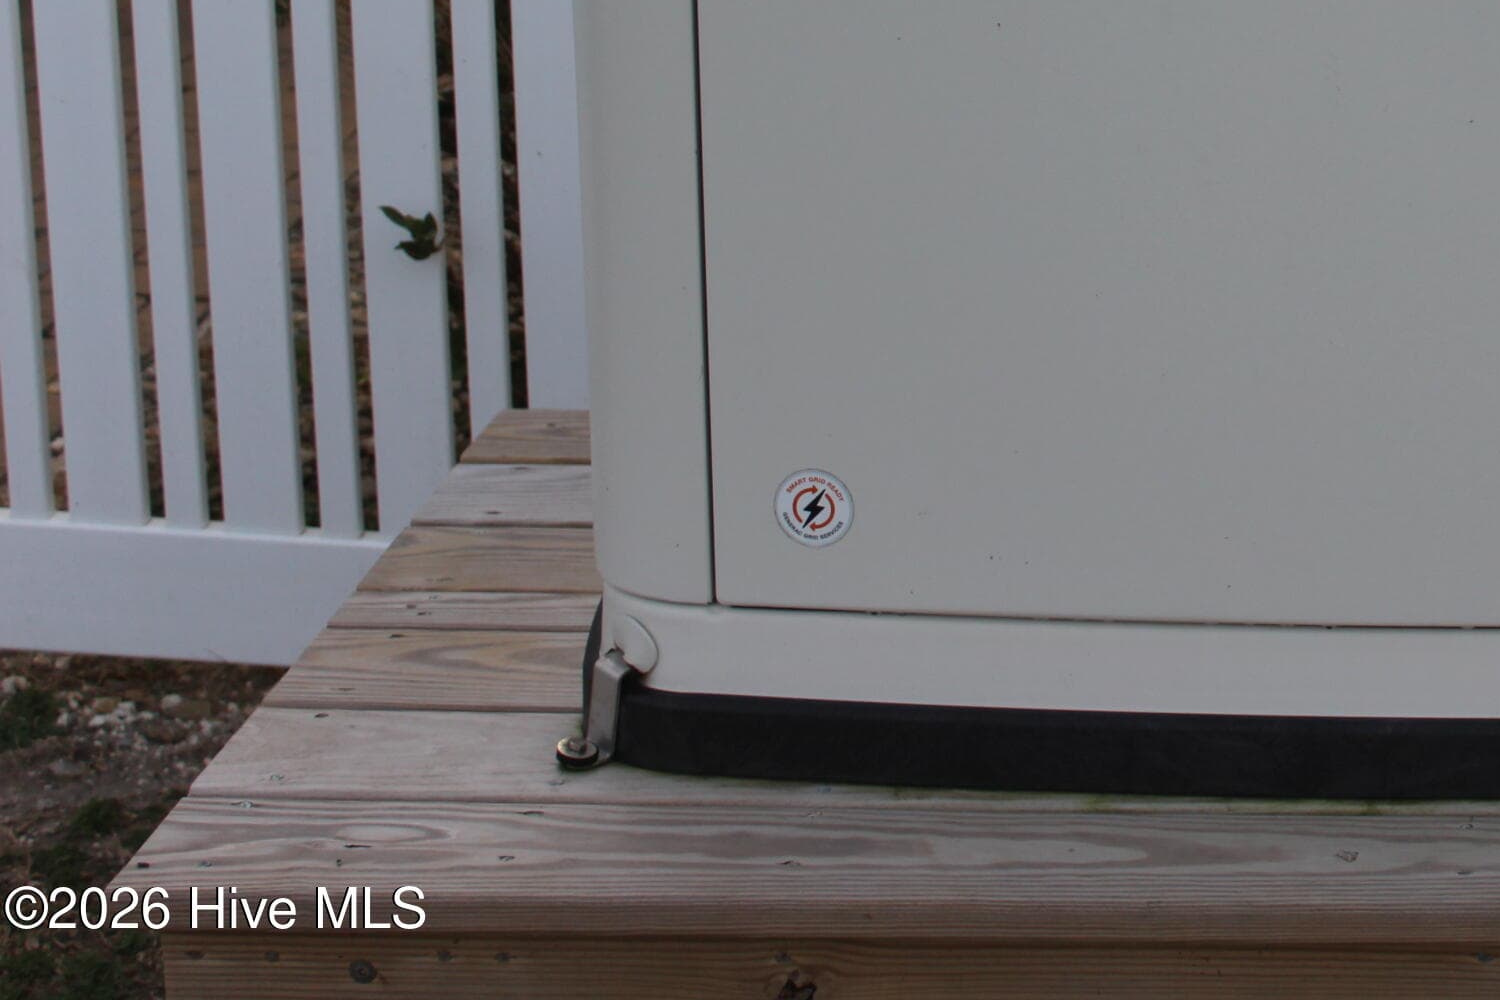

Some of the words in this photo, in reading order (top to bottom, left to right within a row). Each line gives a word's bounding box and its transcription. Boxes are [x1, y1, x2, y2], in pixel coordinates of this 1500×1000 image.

[786, 477, 806, 493] SMART
[808, 476, 826, 484] GRID
[826, 482, 845, 502] READY
